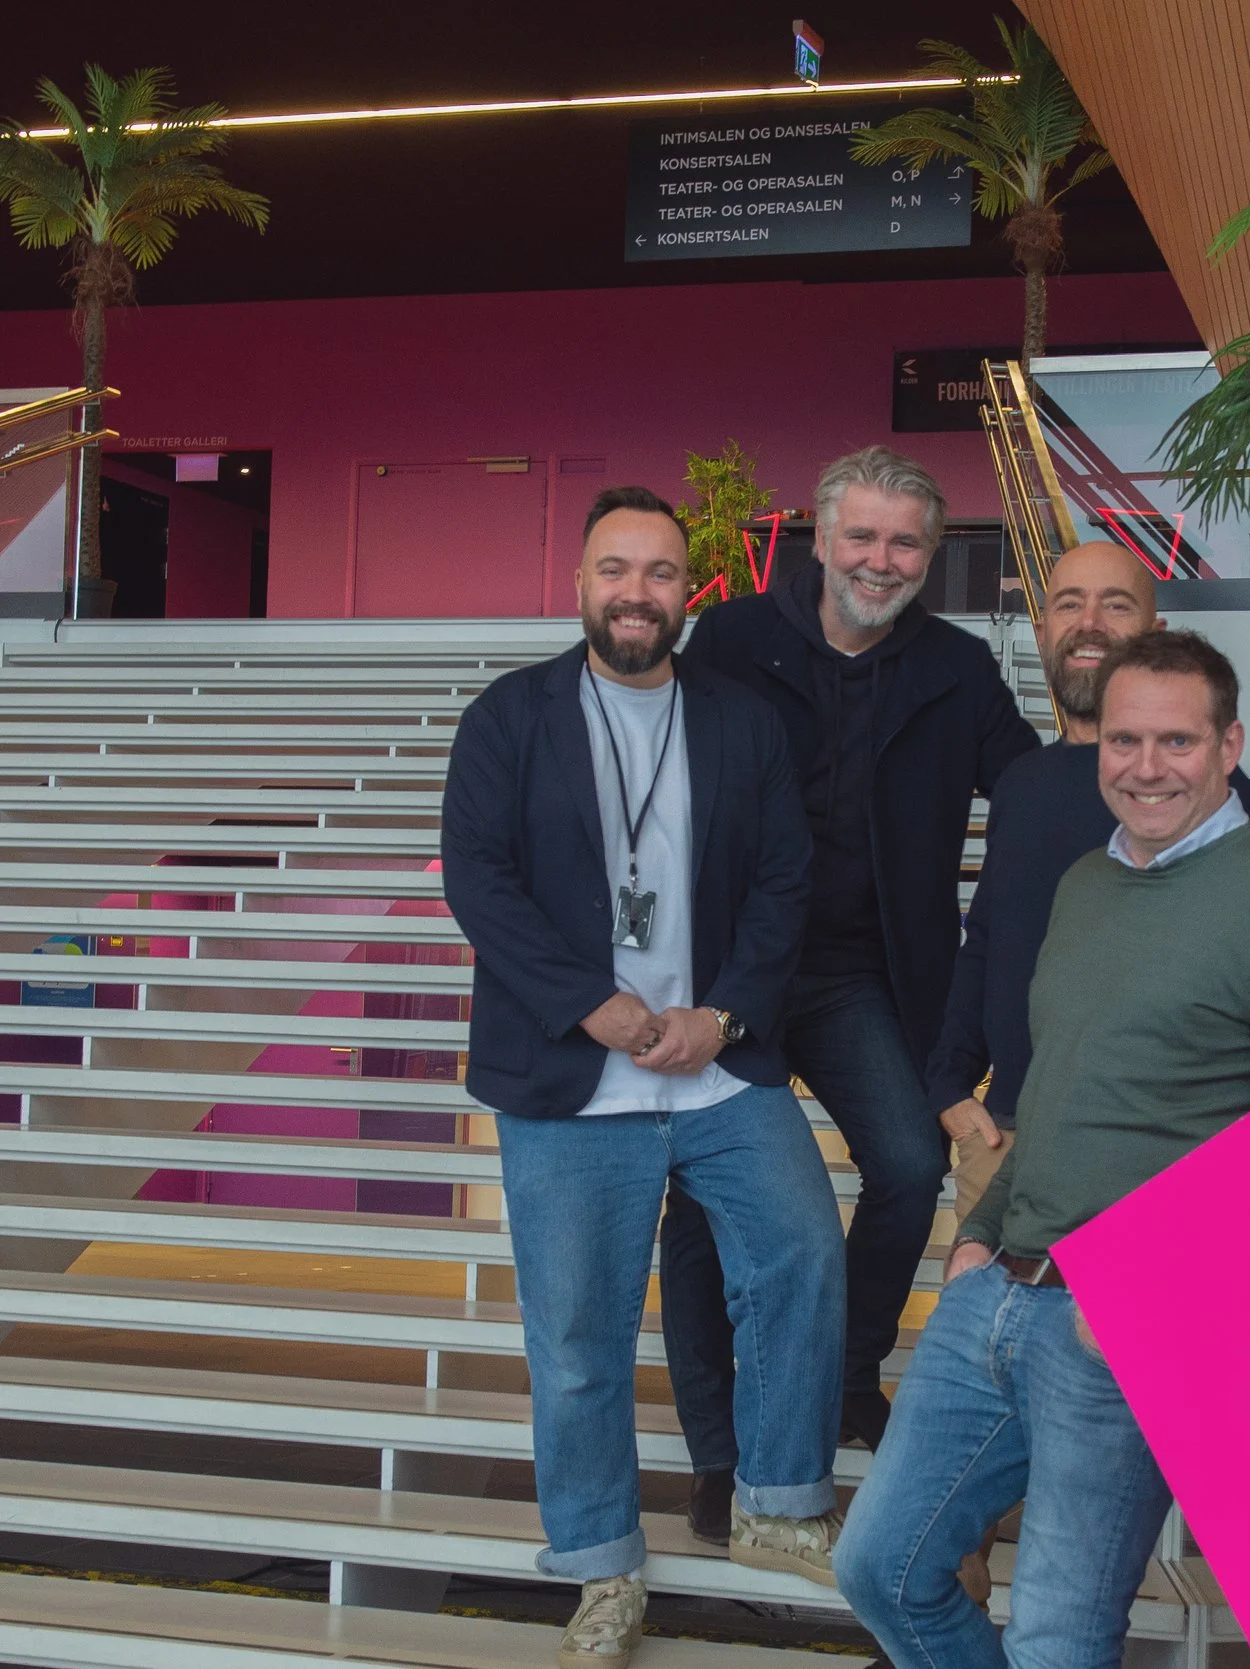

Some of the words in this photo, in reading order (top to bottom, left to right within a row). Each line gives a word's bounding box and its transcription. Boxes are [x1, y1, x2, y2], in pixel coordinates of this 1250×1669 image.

[660, 129, 745, 145] INTIMSALEN
[749, 126, 771, 141] OG
[775, 121, 871, 139] DANSESALEN
[659, 152, 772, 171] KONSERTSALEN
[659, 181, 718, 196] TEATER-
[722, 179, 744, 193] OG
[747, 174, 844, 191] OPERASALEN
[658, 207, 718, 221] TEATER-
[721, 204, 743, 218] OG
[746, 199, 843, 216] OPERASALEN
[911, 195, 921, 206] N
[657, 228, 769, 246] KONSERTSALEN
[890, 222, 900, 233] D
[122, 437, 181, 448] TOALETTER
[183, 436, 228, 447] GALLERI
